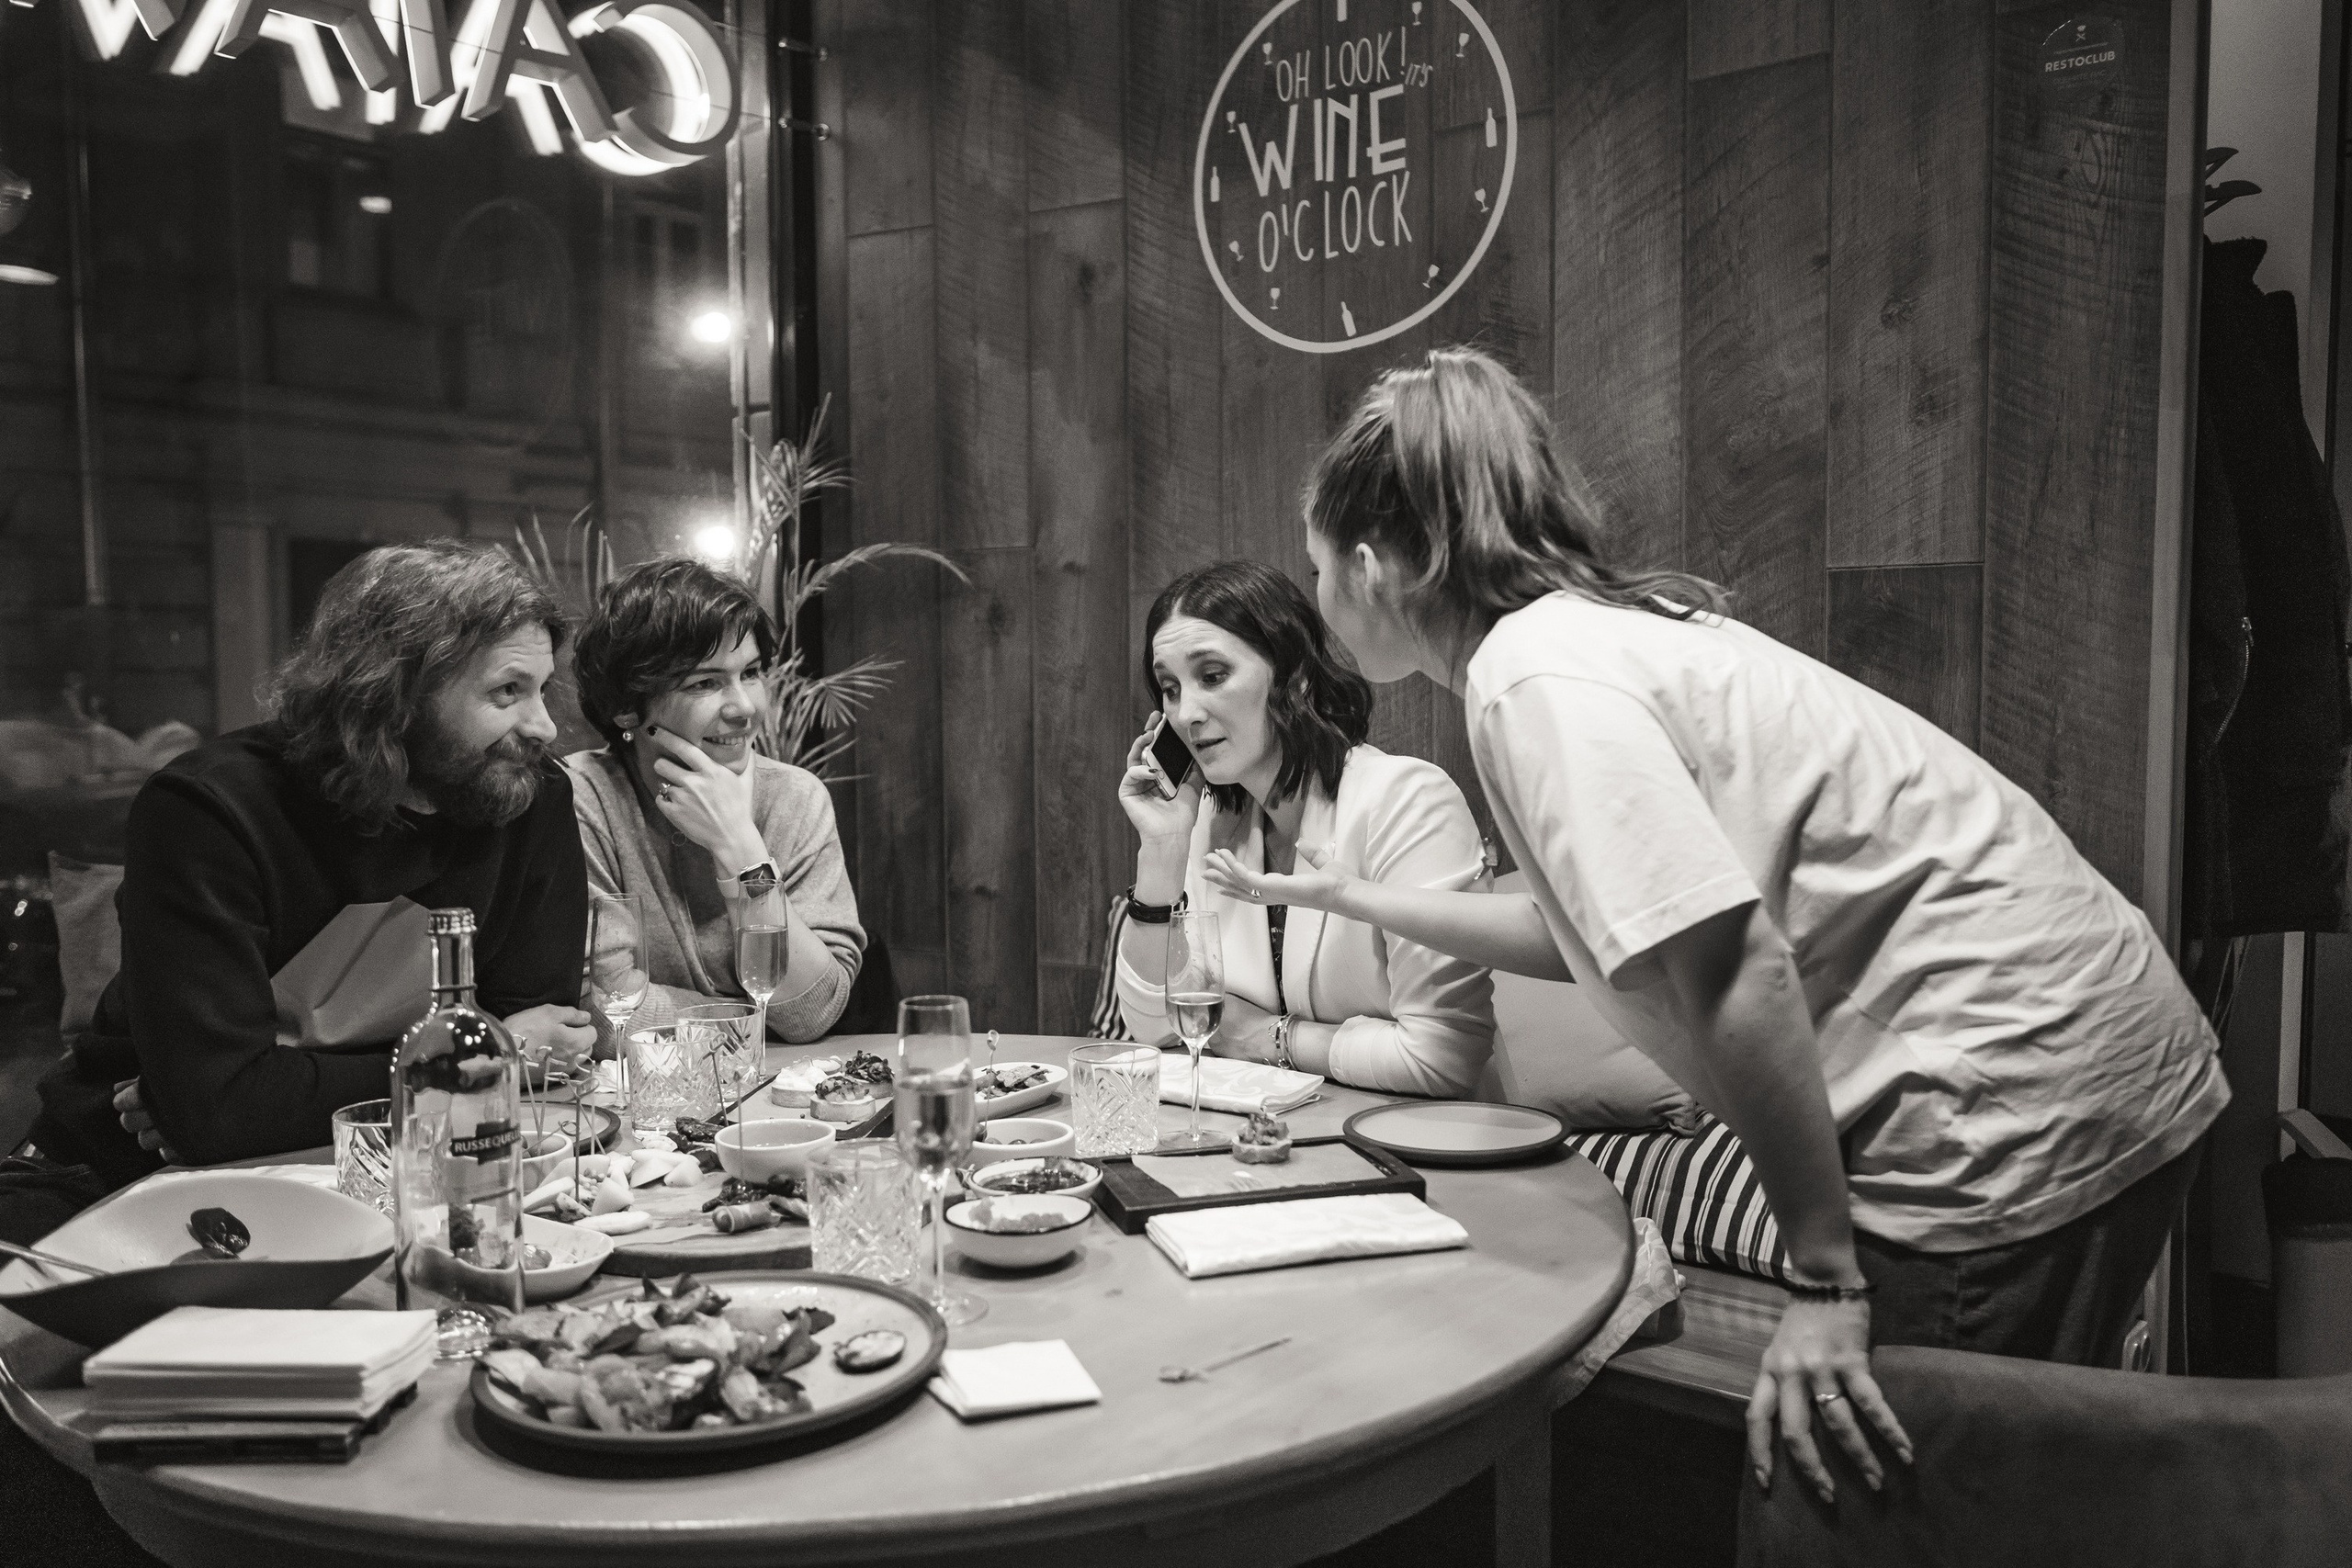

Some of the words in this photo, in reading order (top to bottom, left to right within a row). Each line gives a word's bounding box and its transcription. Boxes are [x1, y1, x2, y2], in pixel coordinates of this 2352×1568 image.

[1276, 50, 1310, 102] OH
[2045, 51, 2115, 73] RESTOCLUB
[1238, 84, 1407, 197] WINE
[1259, 170, 1412, 273] O'CLOCK
